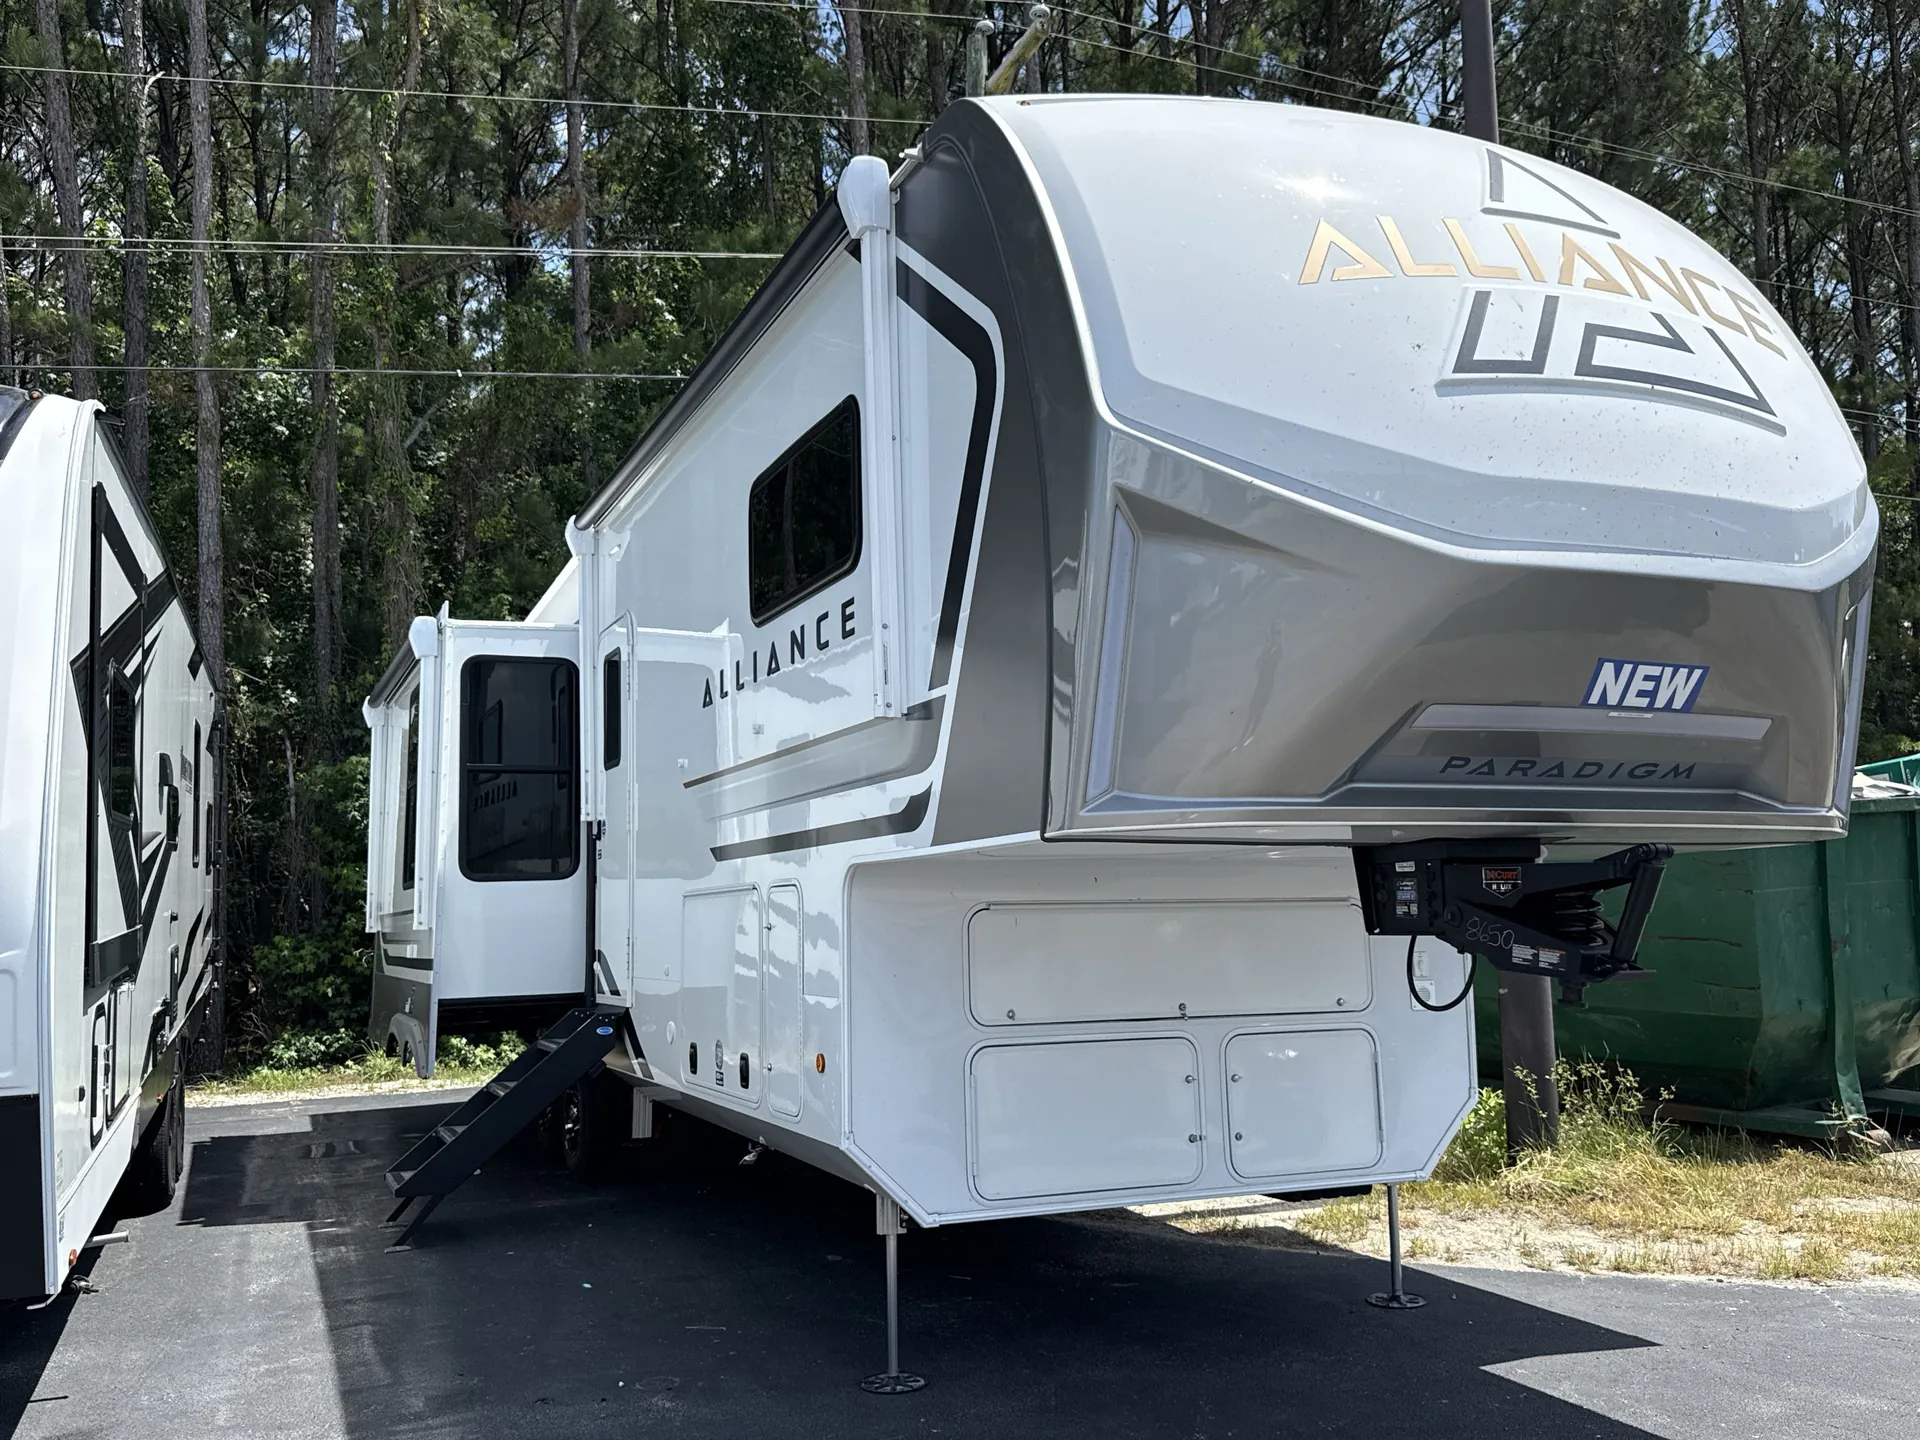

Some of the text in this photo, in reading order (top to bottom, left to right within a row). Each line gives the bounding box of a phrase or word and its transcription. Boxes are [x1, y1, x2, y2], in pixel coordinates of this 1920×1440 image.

[1298, 216, 1787, 361] ALLIANCE
[703, 596, 855, 708] ALLIANCE
[1588, 661, 1702, 709] NEW
[1439, 756, 1697, 780] PARADIGM
[1466, 916, 1515, 949] 8650
